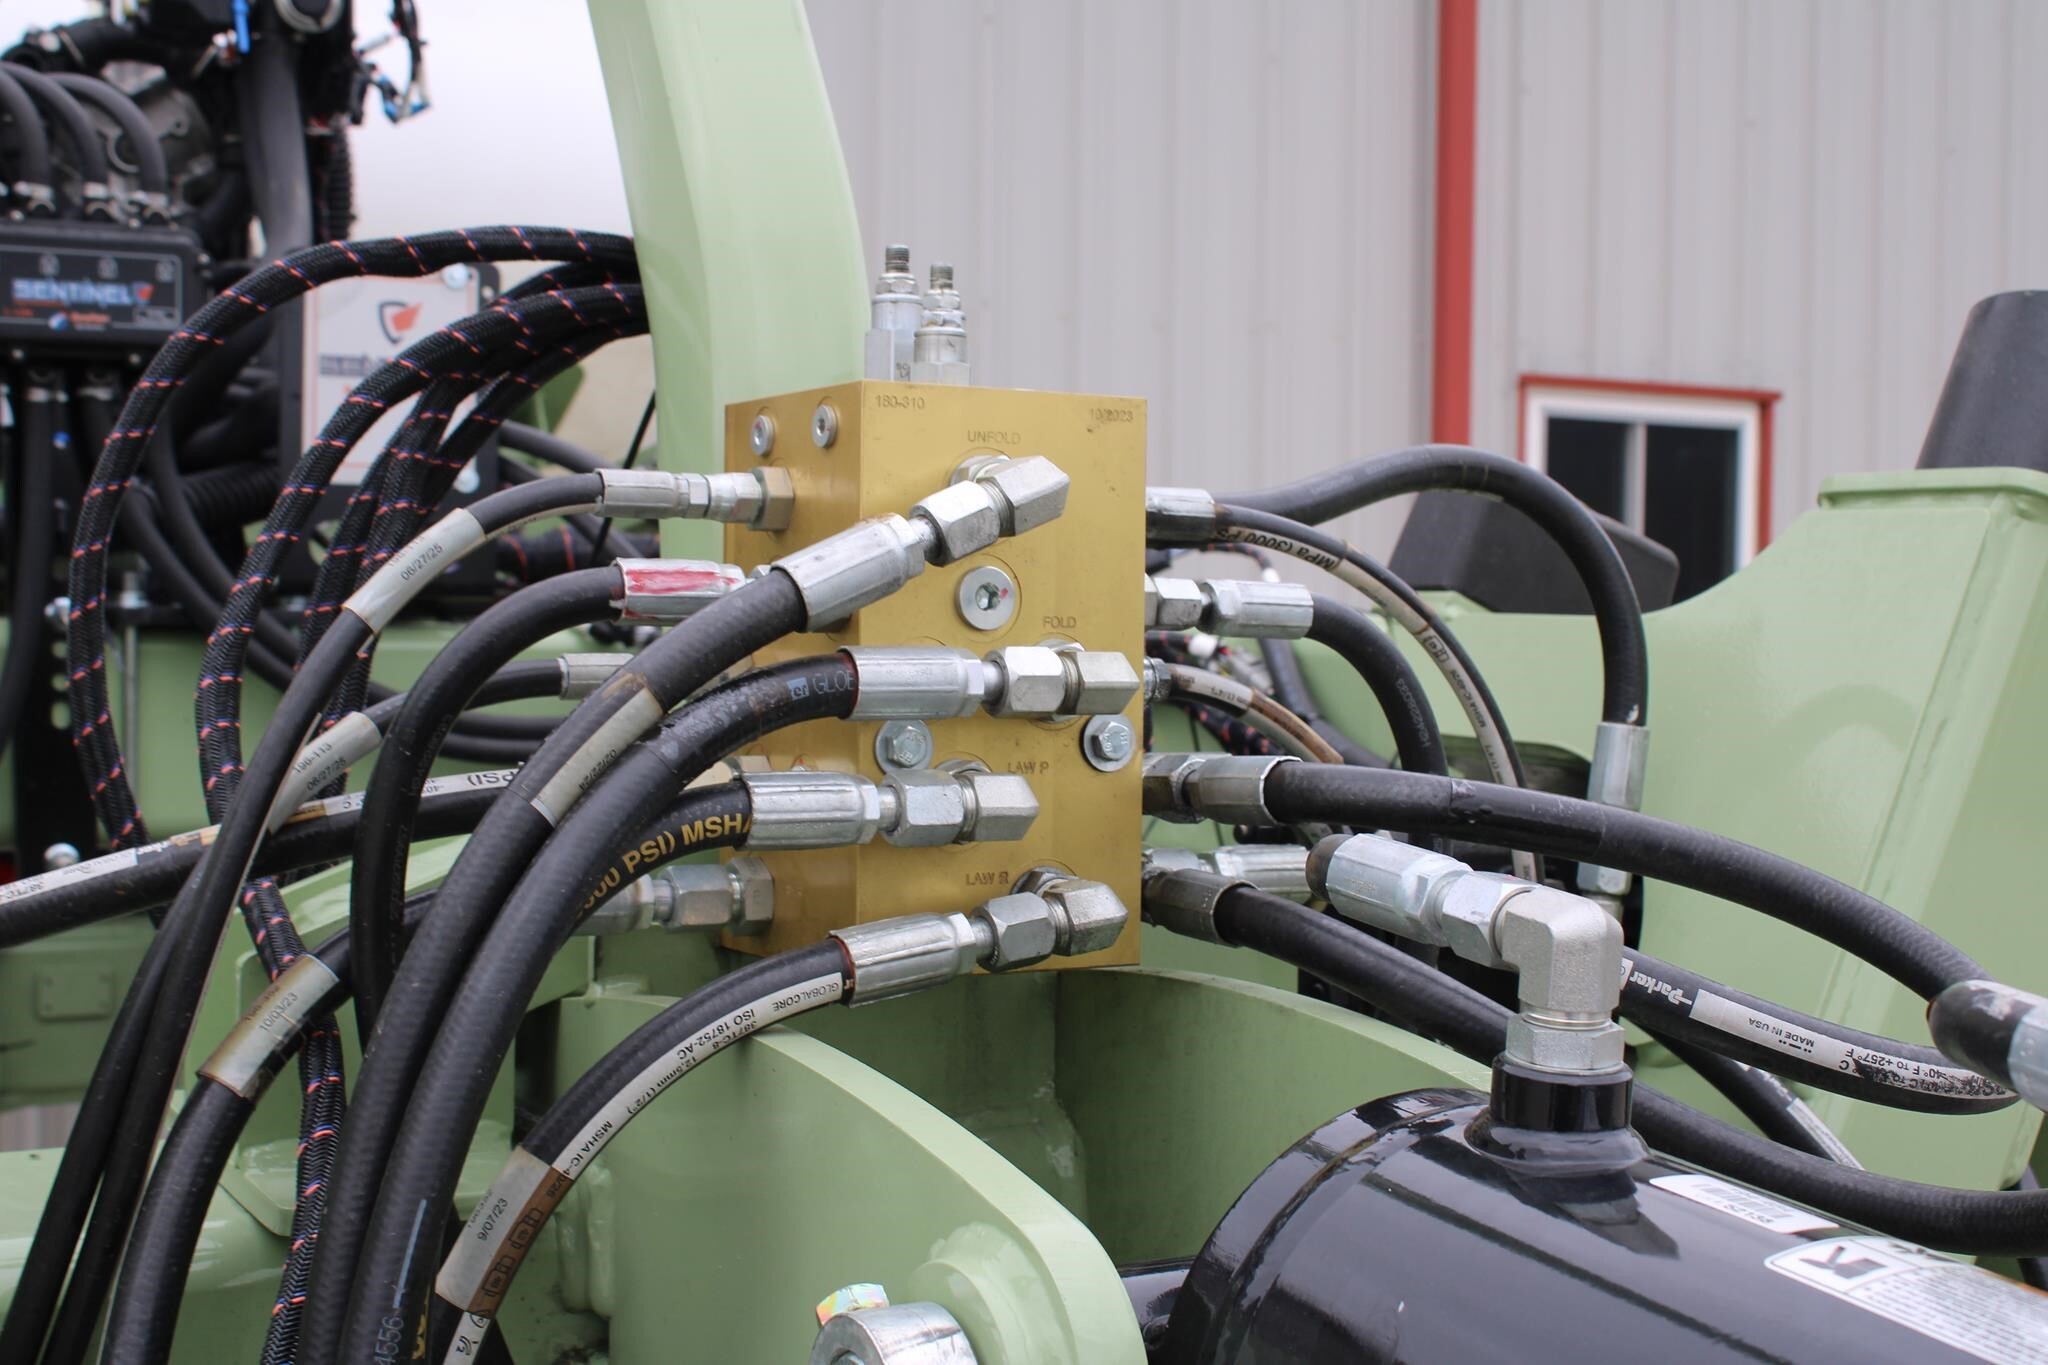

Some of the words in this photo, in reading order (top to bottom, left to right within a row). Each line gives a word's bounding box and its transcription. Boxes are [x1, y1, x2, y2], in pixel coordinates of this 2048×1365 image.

[12, 277, 133, 306] SENTINEL
[967, 430, 1022, 445] UNFOLD
[1042, 615, 1078, 629] FOLD
[1007, 761, 1037, 774] LAW
[1040, 761, 1049, 775] P
[624, 831, 676, 875] PSI)
[965, 872, 996, 886] LAW
[771, 981, 840, 1012] GLOBALCORE
[1630, 970, 1692, 1006] Parker
[732, 1008, 756, 1027] ISO
[1749, 1017, 1770, 1033] USA
[1771, 1028, 1782, 1041] IN
[1783, 1033, 1815, 1048] MADE
[580, 1119, 614, 1154] MSHA
[477, 1197, 509, 1242] 9/07/23
